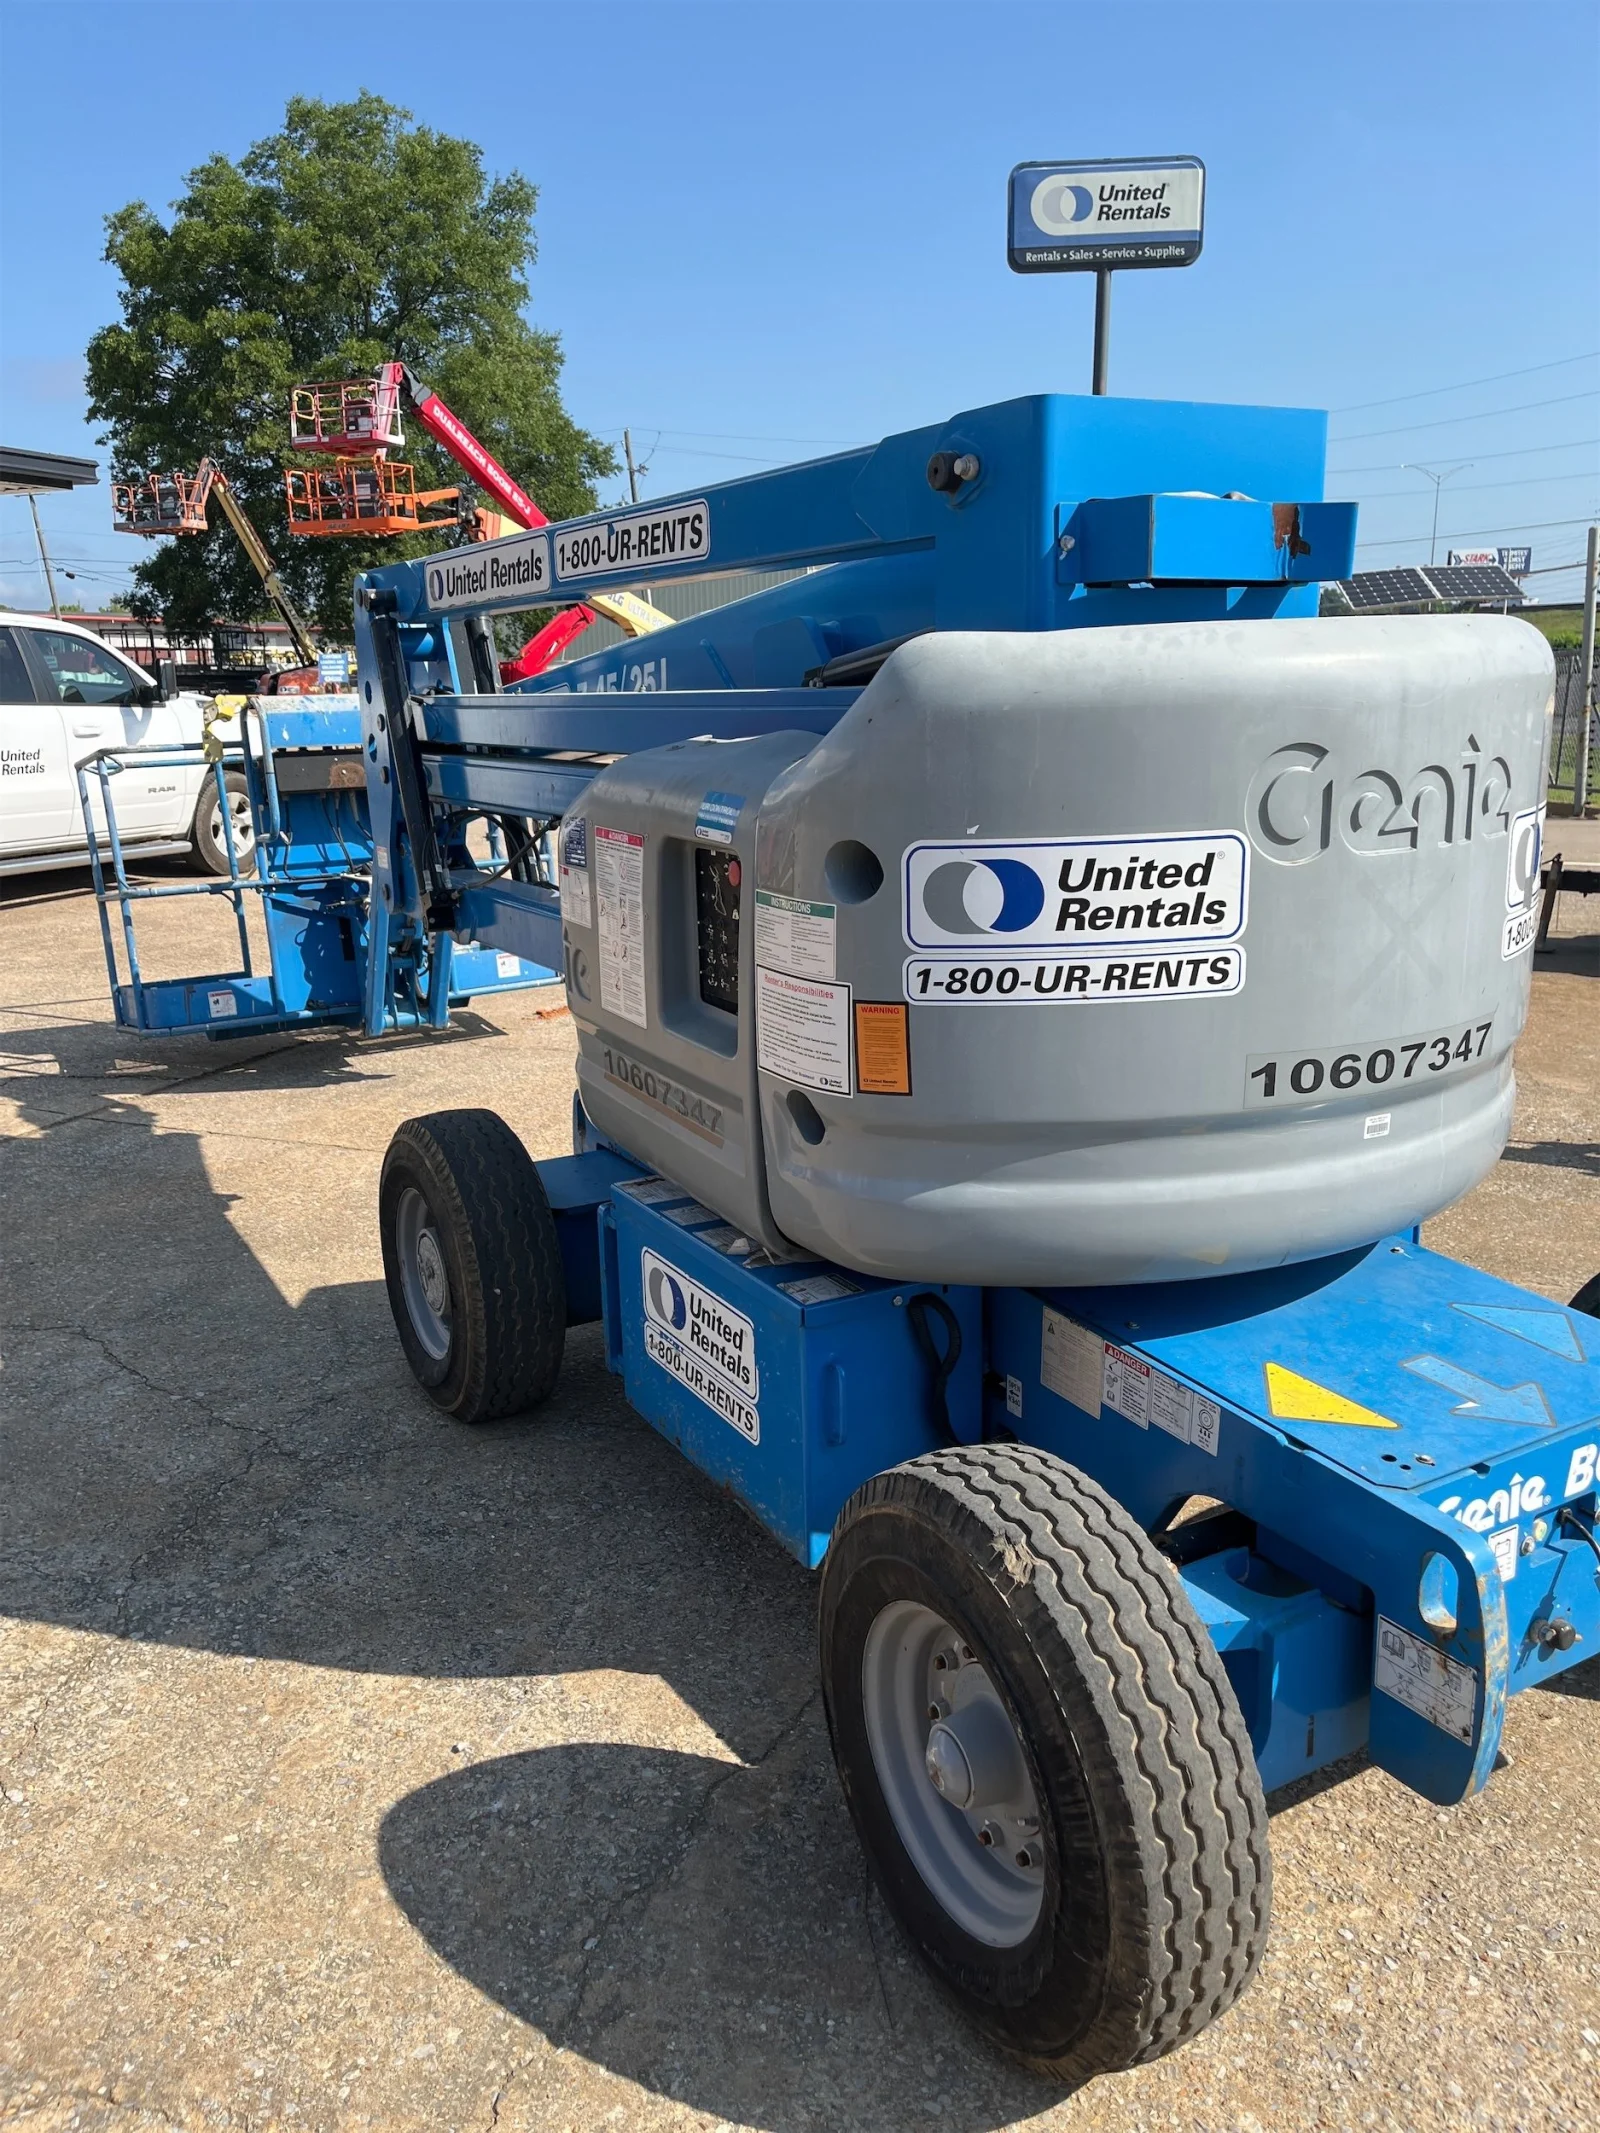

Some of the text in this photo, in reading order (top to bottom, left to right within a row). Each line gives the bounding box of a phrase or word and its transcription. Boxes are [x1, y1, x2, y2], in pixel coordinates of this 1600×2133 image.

[1097, 202, 1171, 221] Rentals
[1098, 182, 1166, 202] United
[1026, 245, 1186, 263] Rentals Sales Service Supplies
[559, 513, 703, 573] 1-800-UR-RENTS
[446, 549, 543, 597] United Rentals
[0, 749, 41, 762] United
[2, 762, 45, 776] Rentals
[1244, 734, 1512, 866] Genie
[1058, 852, 1216, 893] United
[771, 896, 811, 914] INSTRUCTIONS
[1055, 892, 1227, 931] Rentals
[784, 980, 835, 999] Responsibilities
[916, 956, 1232, 995] 1-800-UR-RENTS
[861, 1006, 899, 1015] WARNING
[1251, 1021, 1493, 1098] 10607347
[604, 1049, 722, 1132] 10607347
[689, 1292, 744, 1351] United
[691, 1320, 750, 1385] Rentals
[1114, 1352, 1147, 1375] DANGER
[648, 1333, 754, 1433] 1-800-UR-RENTS
